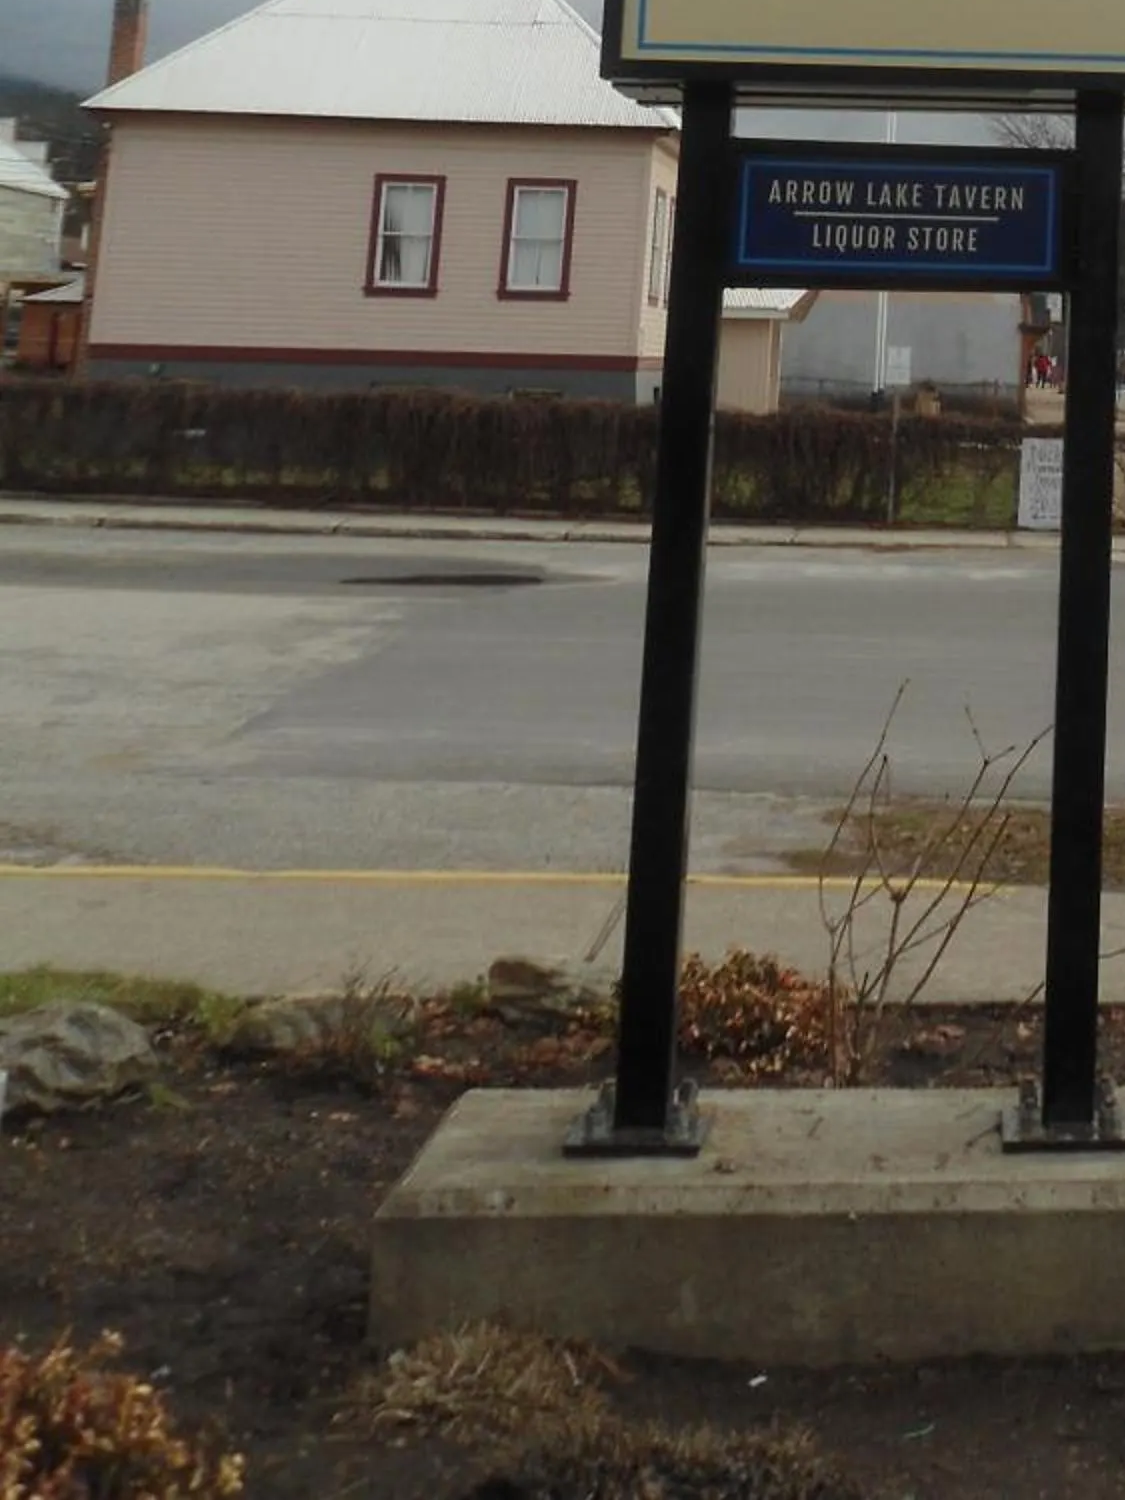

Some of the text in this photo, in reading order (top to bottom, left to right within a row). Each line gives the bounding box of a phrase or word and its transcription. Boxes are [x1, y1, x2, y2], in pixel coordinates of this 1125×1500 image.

[768, 179, 1025, 211] ARROW LAKE TAVERN
[812, 223, 978, 252] LIQUOR STORE
